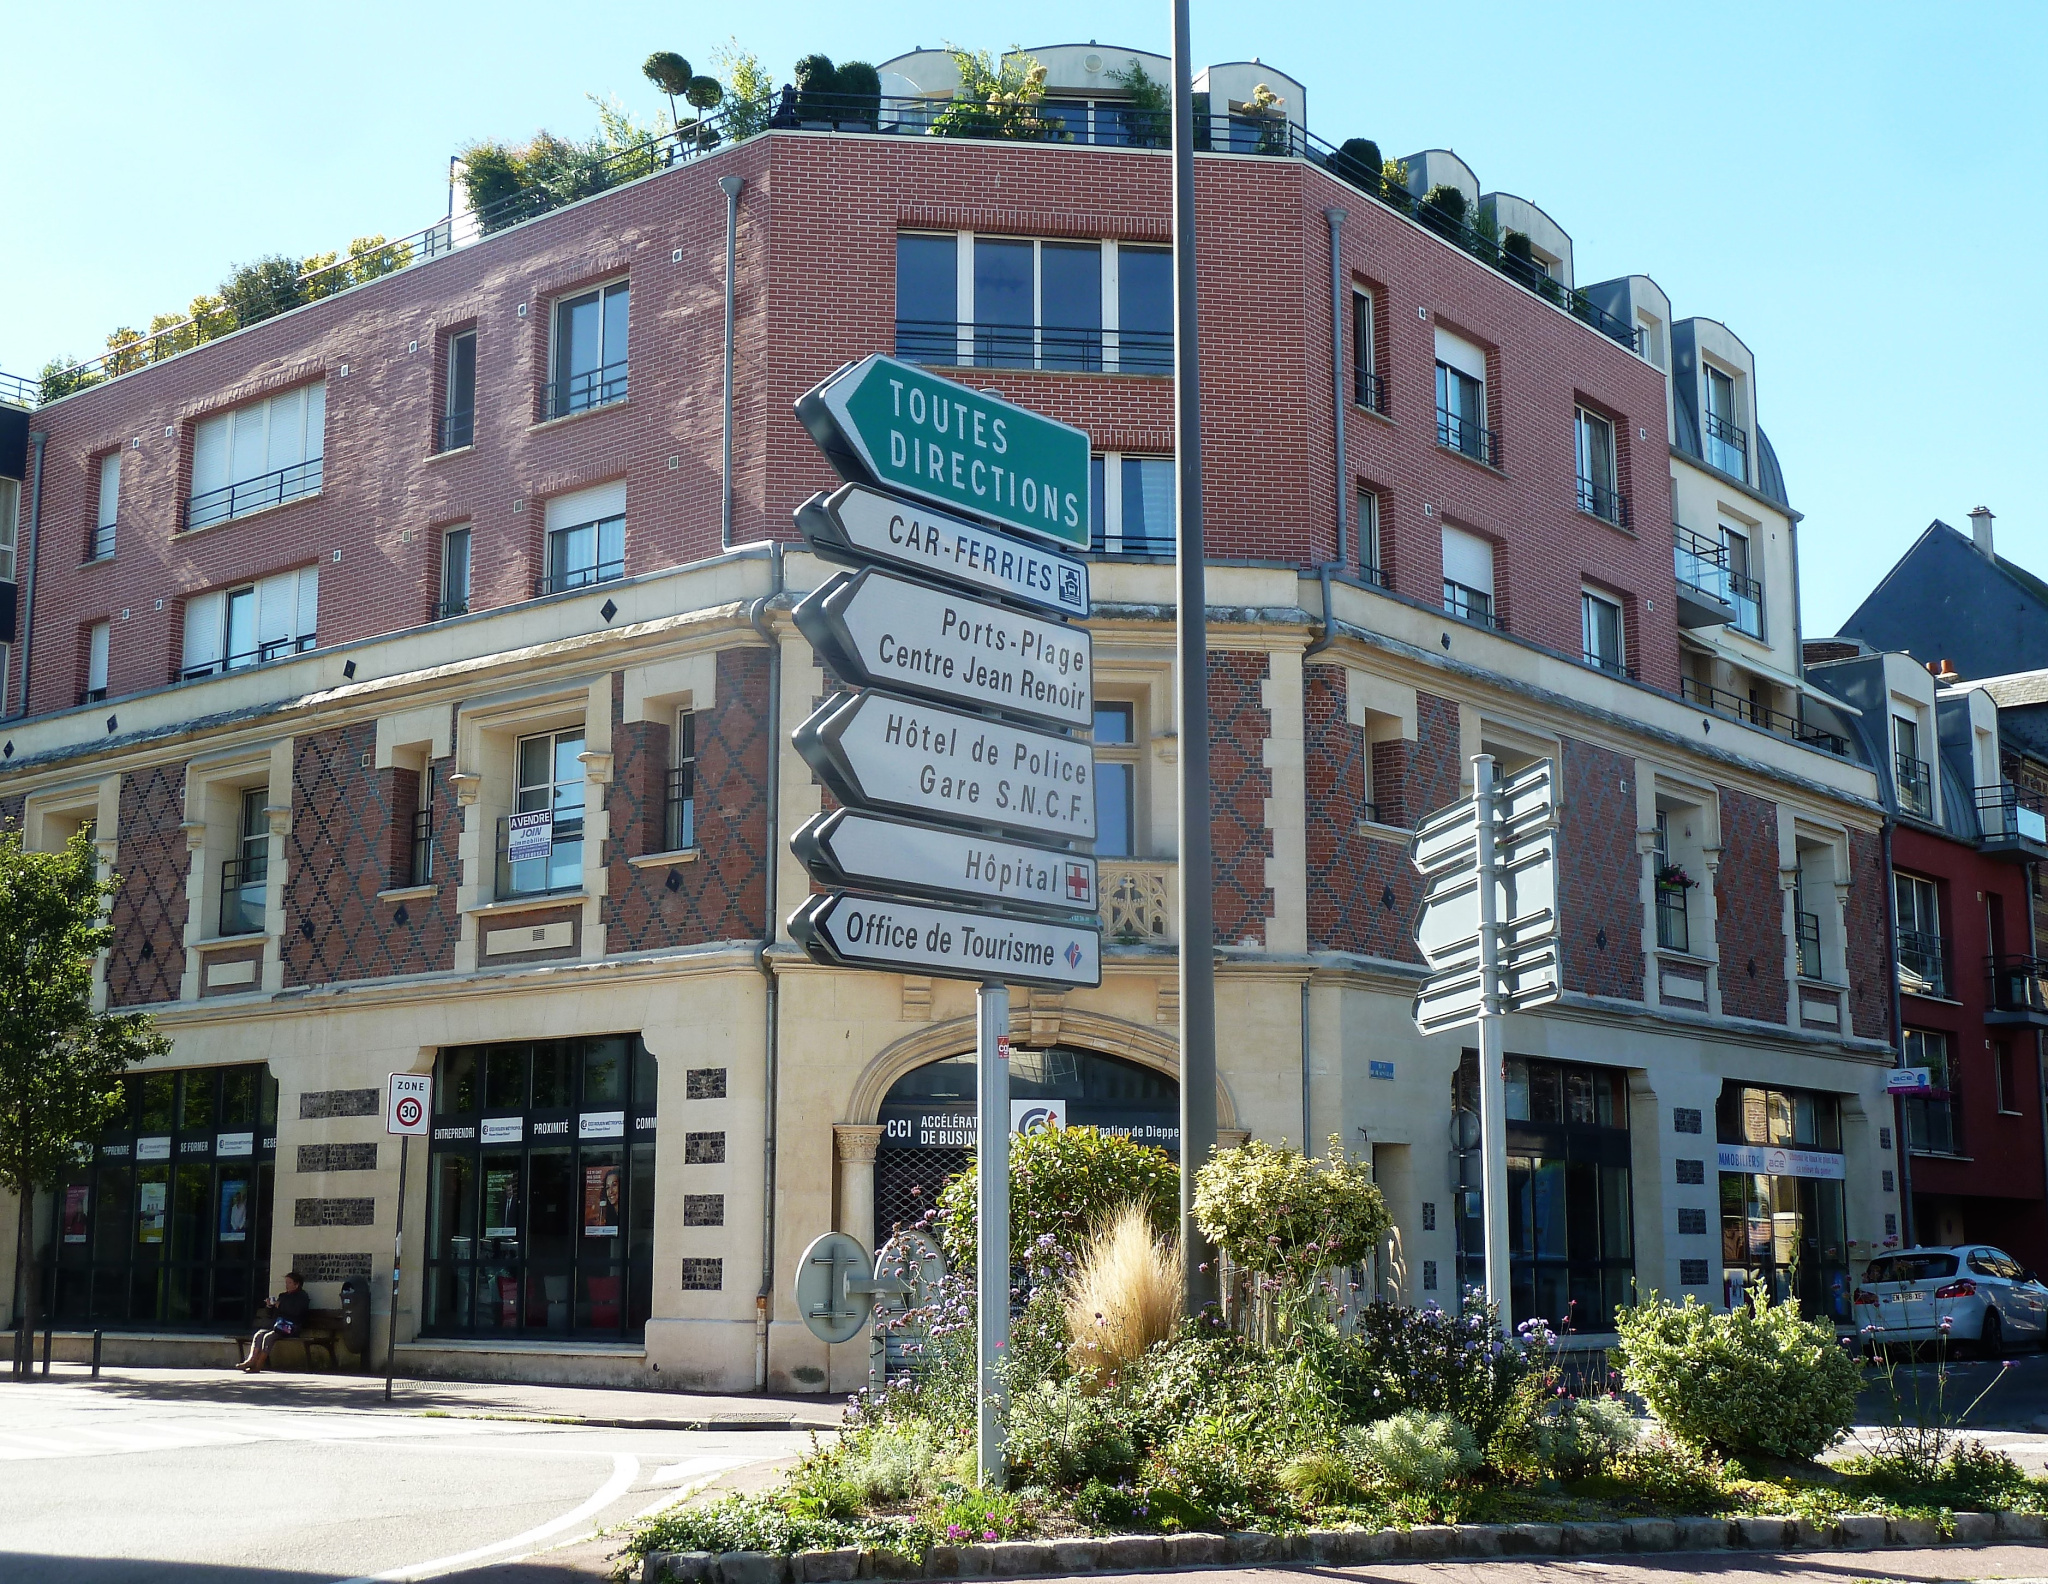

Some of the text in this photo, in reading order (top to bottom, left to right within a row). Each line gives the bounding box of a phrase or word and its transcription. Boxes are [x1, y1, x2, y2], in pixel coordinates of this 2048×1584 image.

[889, 378, 1008, 454] TOUTES
[890, 429, 1080, 527] DIRECTIONS
[889, 514, 1052, 591] CAR-FERRIES
[941, 607, 1084, 675] Ports-Plage
[879, 633, 1085, 710] Centre Jean Renoir
[885, 713, 1087, 785] Hôtel de Police
[920, 764, 1088, 824] Gare S.N.C.F.
[517, 812, 550, 826] VENDRE
[520, 826, 543, 839] JOIN
[965, 849, 1058, 892] Hôpital
[846, 911, 1055, 965] Office de Tourisme
[397, 1081, 424, 1091] ZONE
[401, 1105, 417, 1118] 30
[533, 1118, 569, 1135] PROXIMITÉ
[887, 1119, 912, 1138] CCI
[920, 1130, 936, 1145] DE
[1131, 1125, 1144, 1138] de
[1146, 1125, 1180, 1140] Dieppe
[187, 1141, 209, 1153] FORMER
